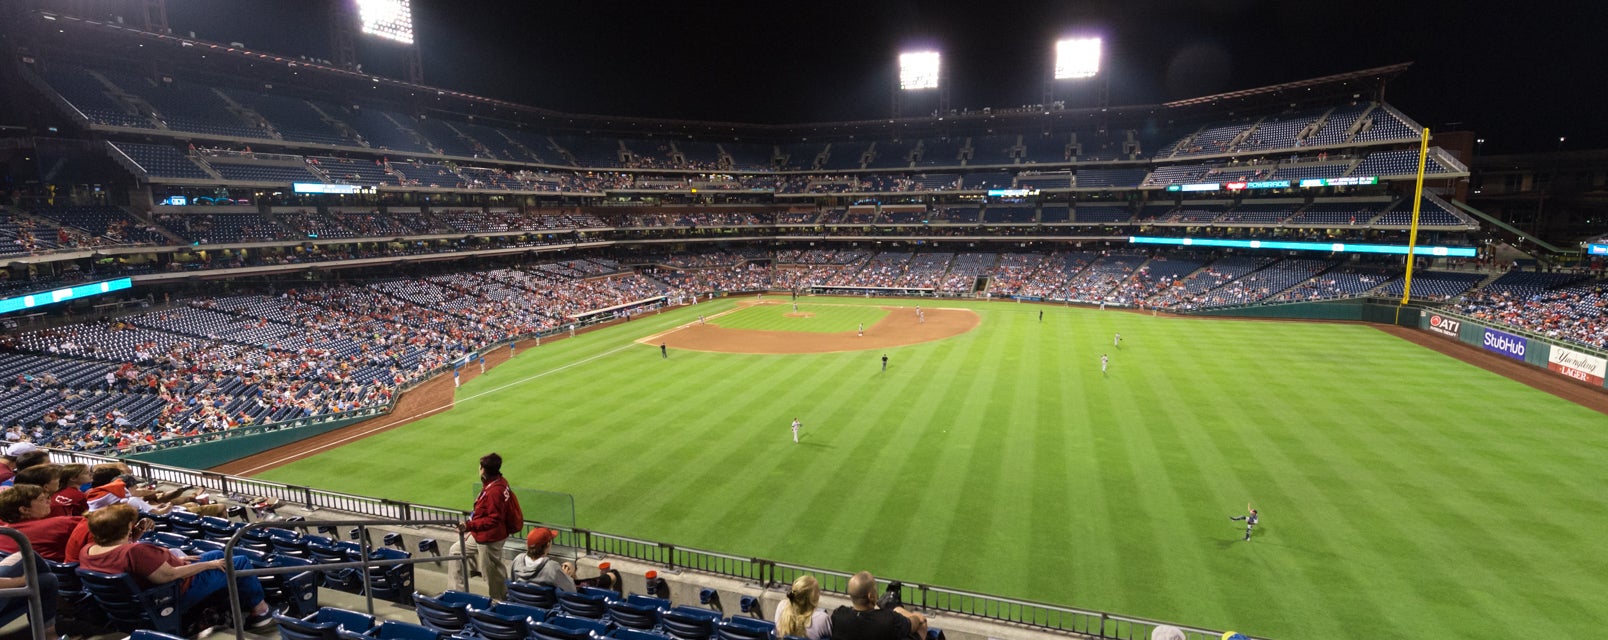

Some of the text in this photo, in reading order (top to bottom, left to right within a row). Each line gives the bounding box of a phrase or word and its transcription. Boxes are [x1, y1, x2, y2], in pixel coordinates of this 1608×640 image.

[1439, 319, 1460, 332] ATI
[1484, 332, 1525, 356] StubHub
[1555, 349, 1597, 372] Yuengling
[1561, 367, 1587, 381] LAGER
